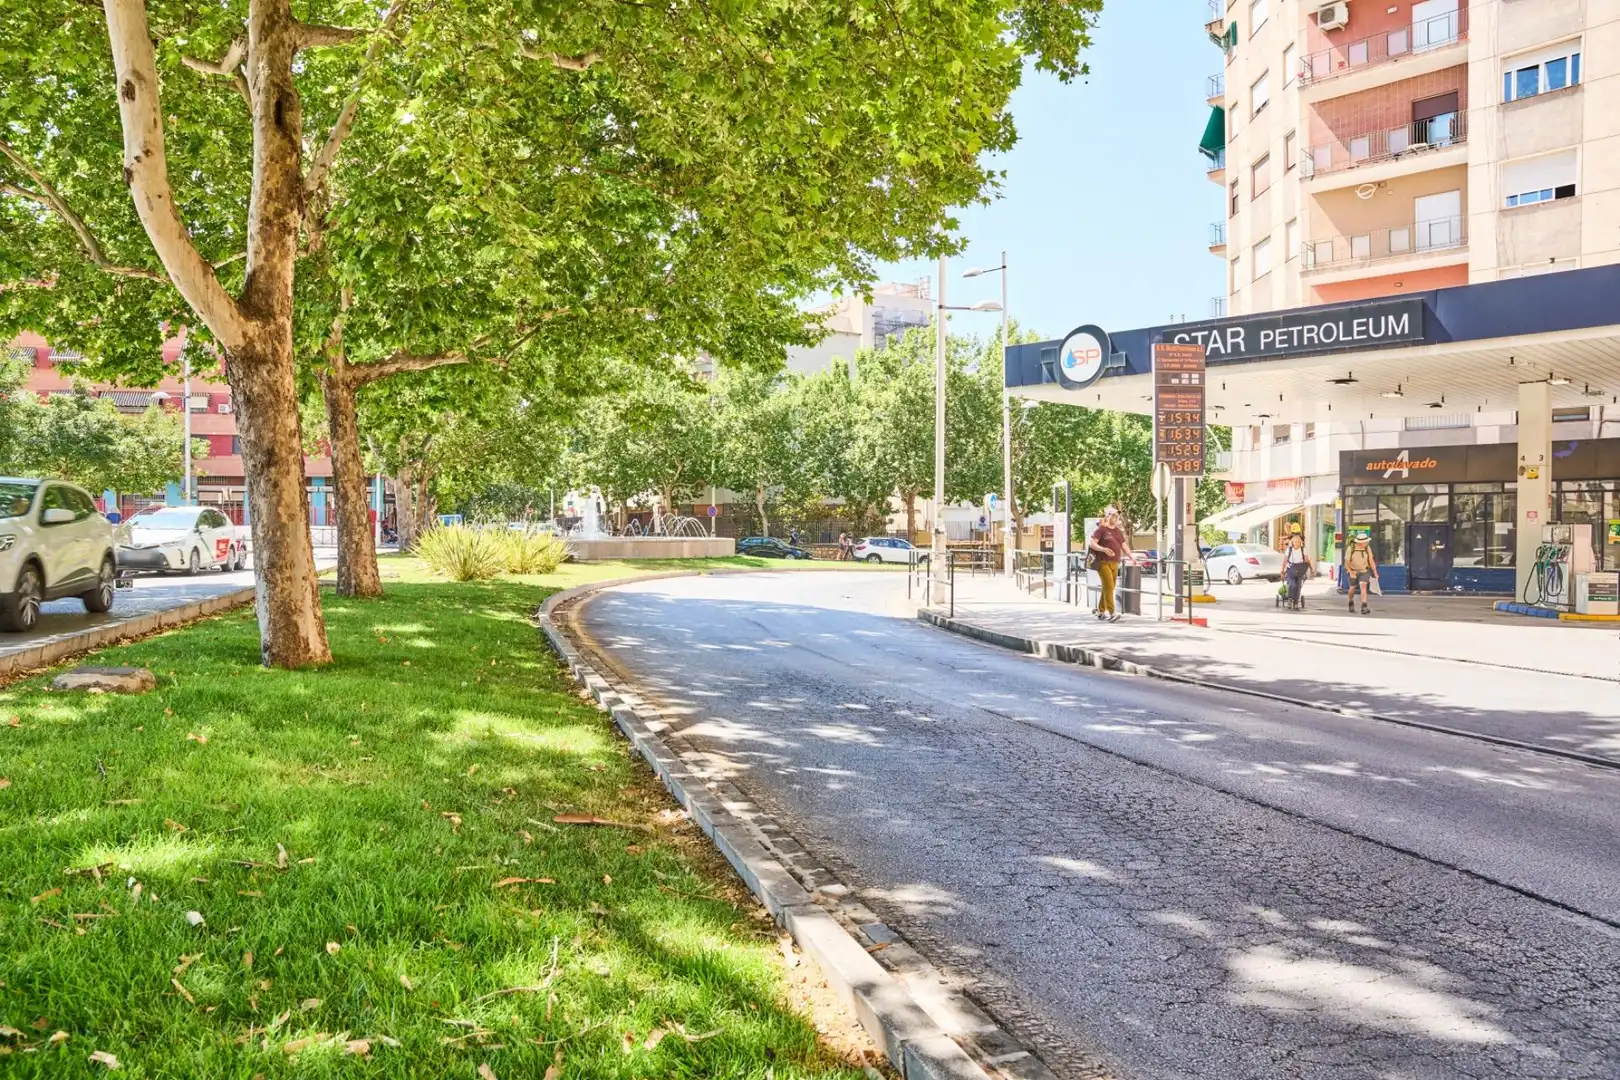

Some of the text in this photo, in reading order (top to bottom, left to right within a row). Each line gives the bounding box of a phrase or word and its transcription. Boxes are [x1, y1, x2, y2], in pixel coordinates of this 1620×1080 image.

[1260, 313, 1409, 350] PETROLEUM
[1071, 349, 1100, 365] SP
[1365, 457, 1437, 471] autolavado
